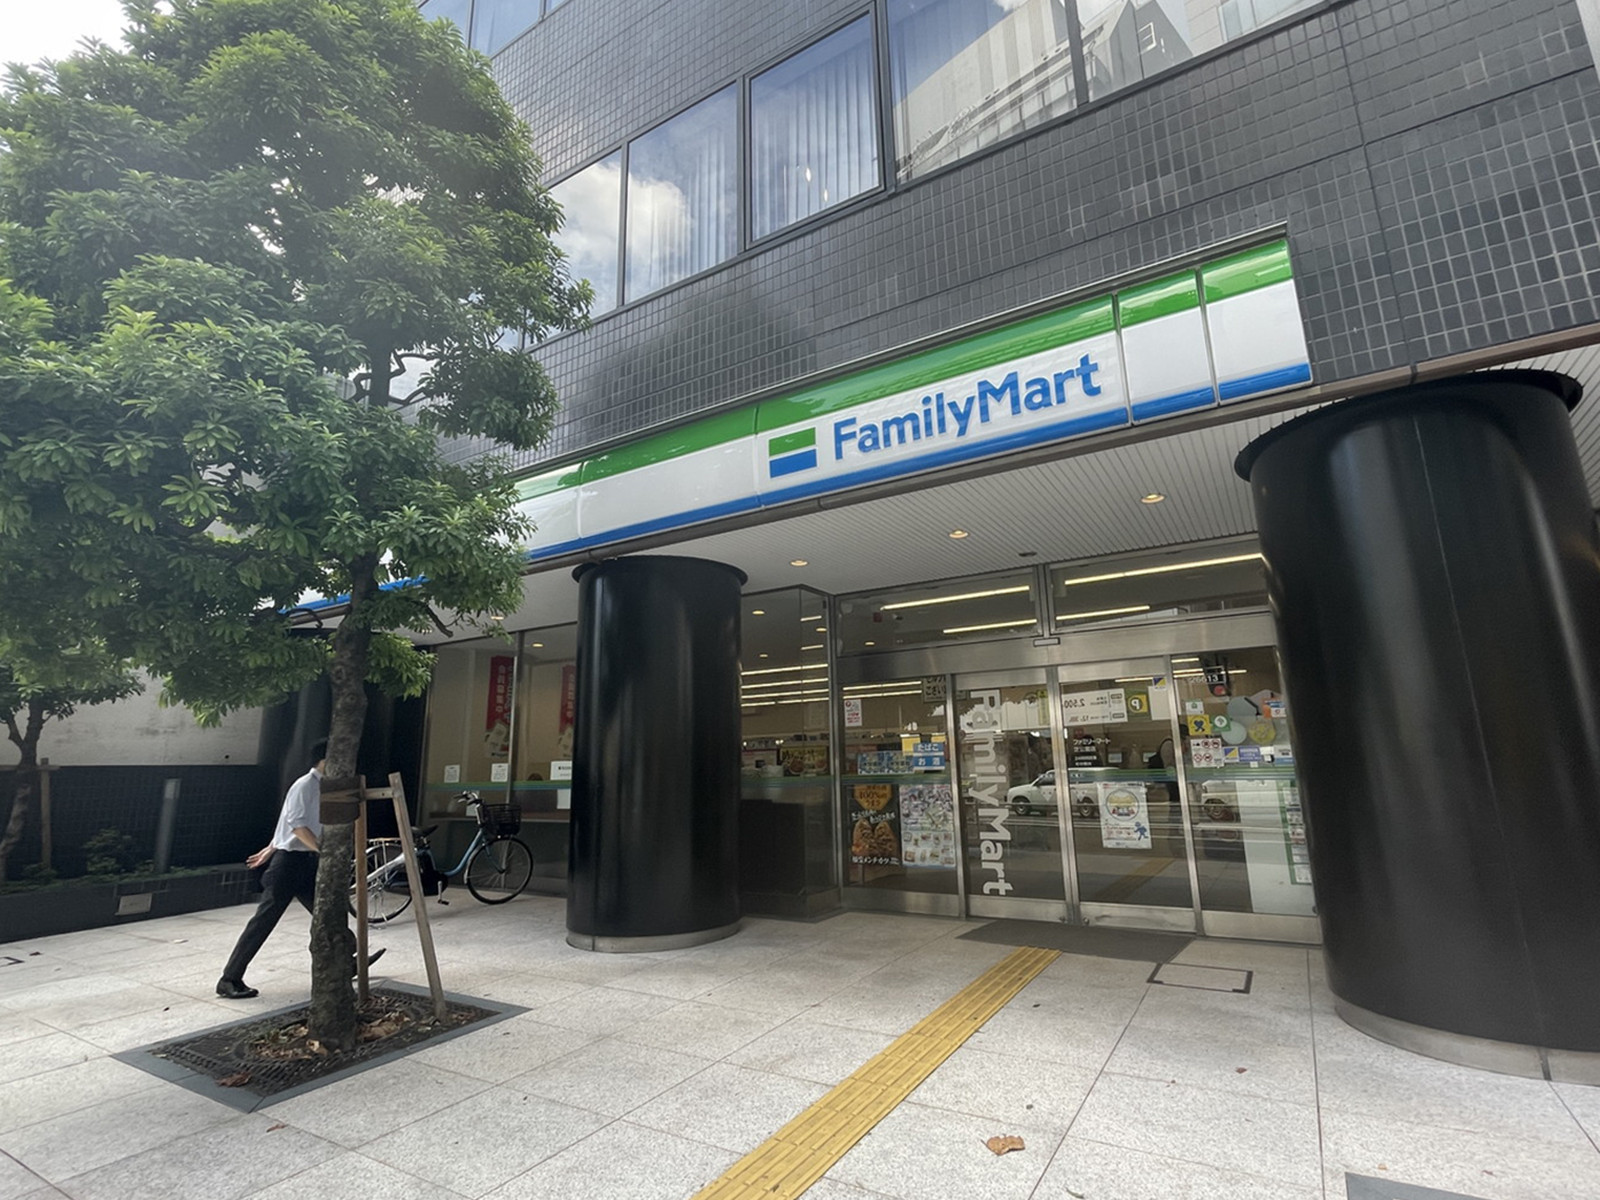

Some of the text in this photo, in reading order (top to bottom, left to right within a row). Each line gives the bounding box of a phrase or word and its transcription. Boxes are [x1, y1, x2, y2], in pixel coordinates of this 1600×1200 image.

[834, 353, 1101, 460] FamilyMart
[918, 743, 939, 751] たばこ
[969, 689, 1014, 895] FamilyMart
